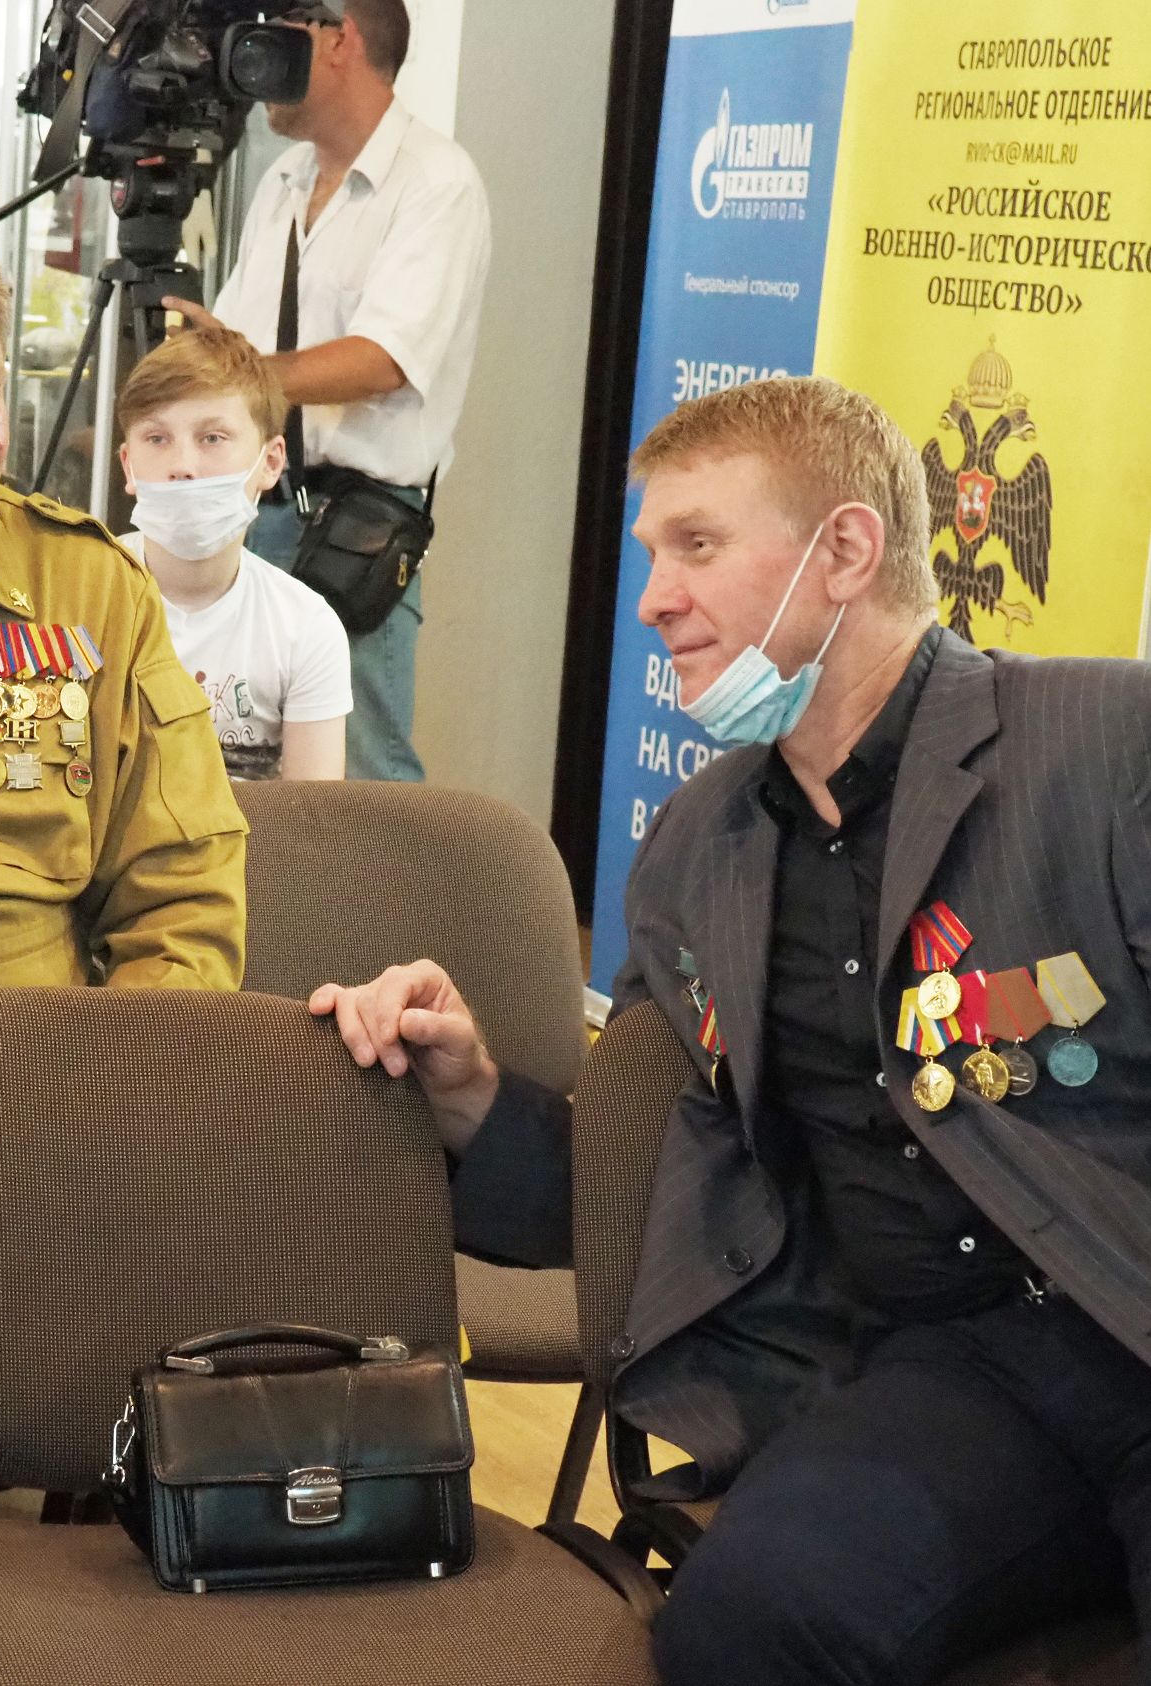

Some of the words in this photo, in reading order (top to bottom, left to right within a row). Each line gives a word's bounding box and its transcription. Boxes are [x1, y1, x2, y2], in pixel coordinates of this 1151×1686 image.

[958, 37, 1112, 70] СТАВРОПОЛЬСКОЕ
[915, 90, 1040, 120] РЕГИОНАЛЬНОЕ
[727, 123, 814, 168] ГАЗПРОМ
[722, 201, 807, 220] СТАВРОПОЛЬ
[928, 178, 1112, 222] «РОССИЙСКОЕ
[927, 275, 1084, 316] ОБЩЕСТВО»
[637, 726, 671, 777] НА
